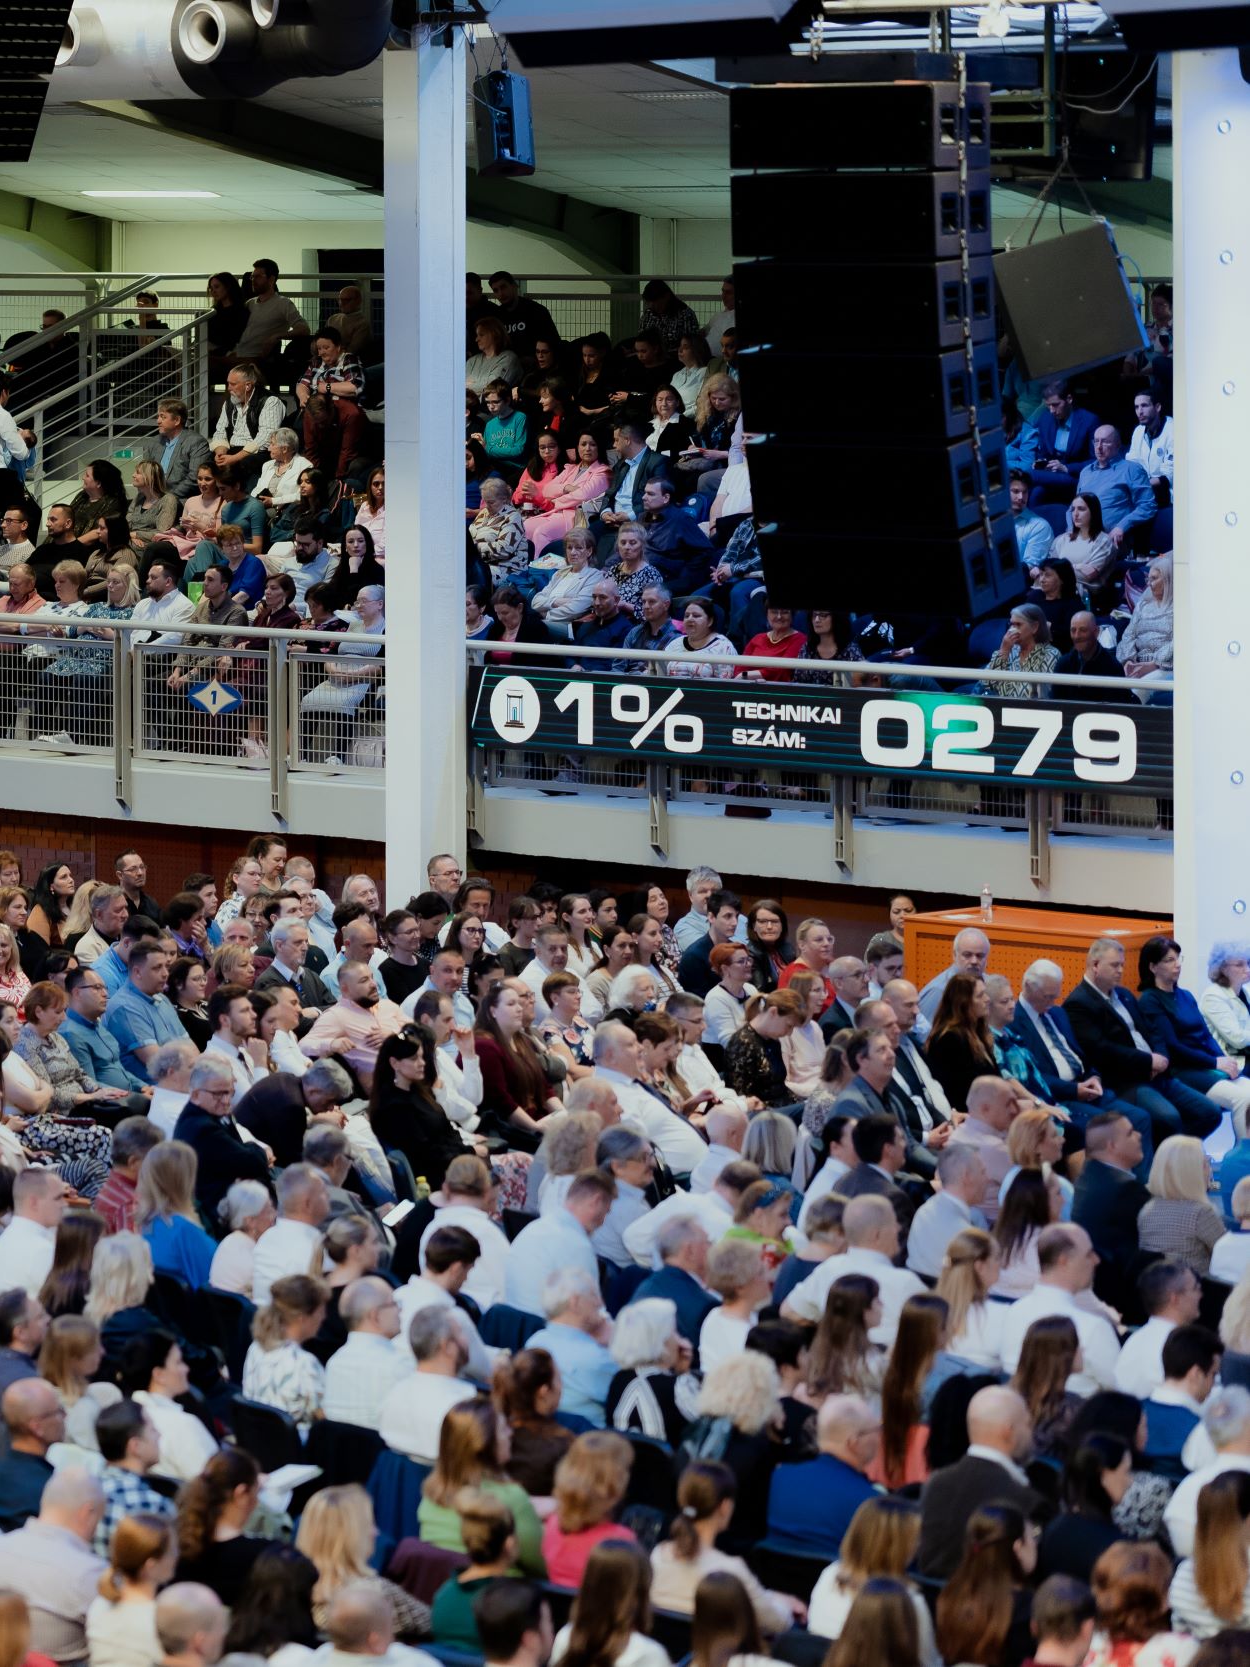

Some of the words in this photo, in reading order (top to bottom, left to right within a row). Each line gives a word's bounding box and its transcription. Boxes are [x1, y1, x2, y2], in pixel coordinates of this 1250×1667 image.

[503, 321, 526, 334] UGO
[210, 690, 217, 705] 1
[553, 682, 704, 753] 1%
[732, 701, 841, 725] TECHNIKAI
[732, 725, 806, 749] SZÁM:
[860, 699, 1137, 783] 0279
